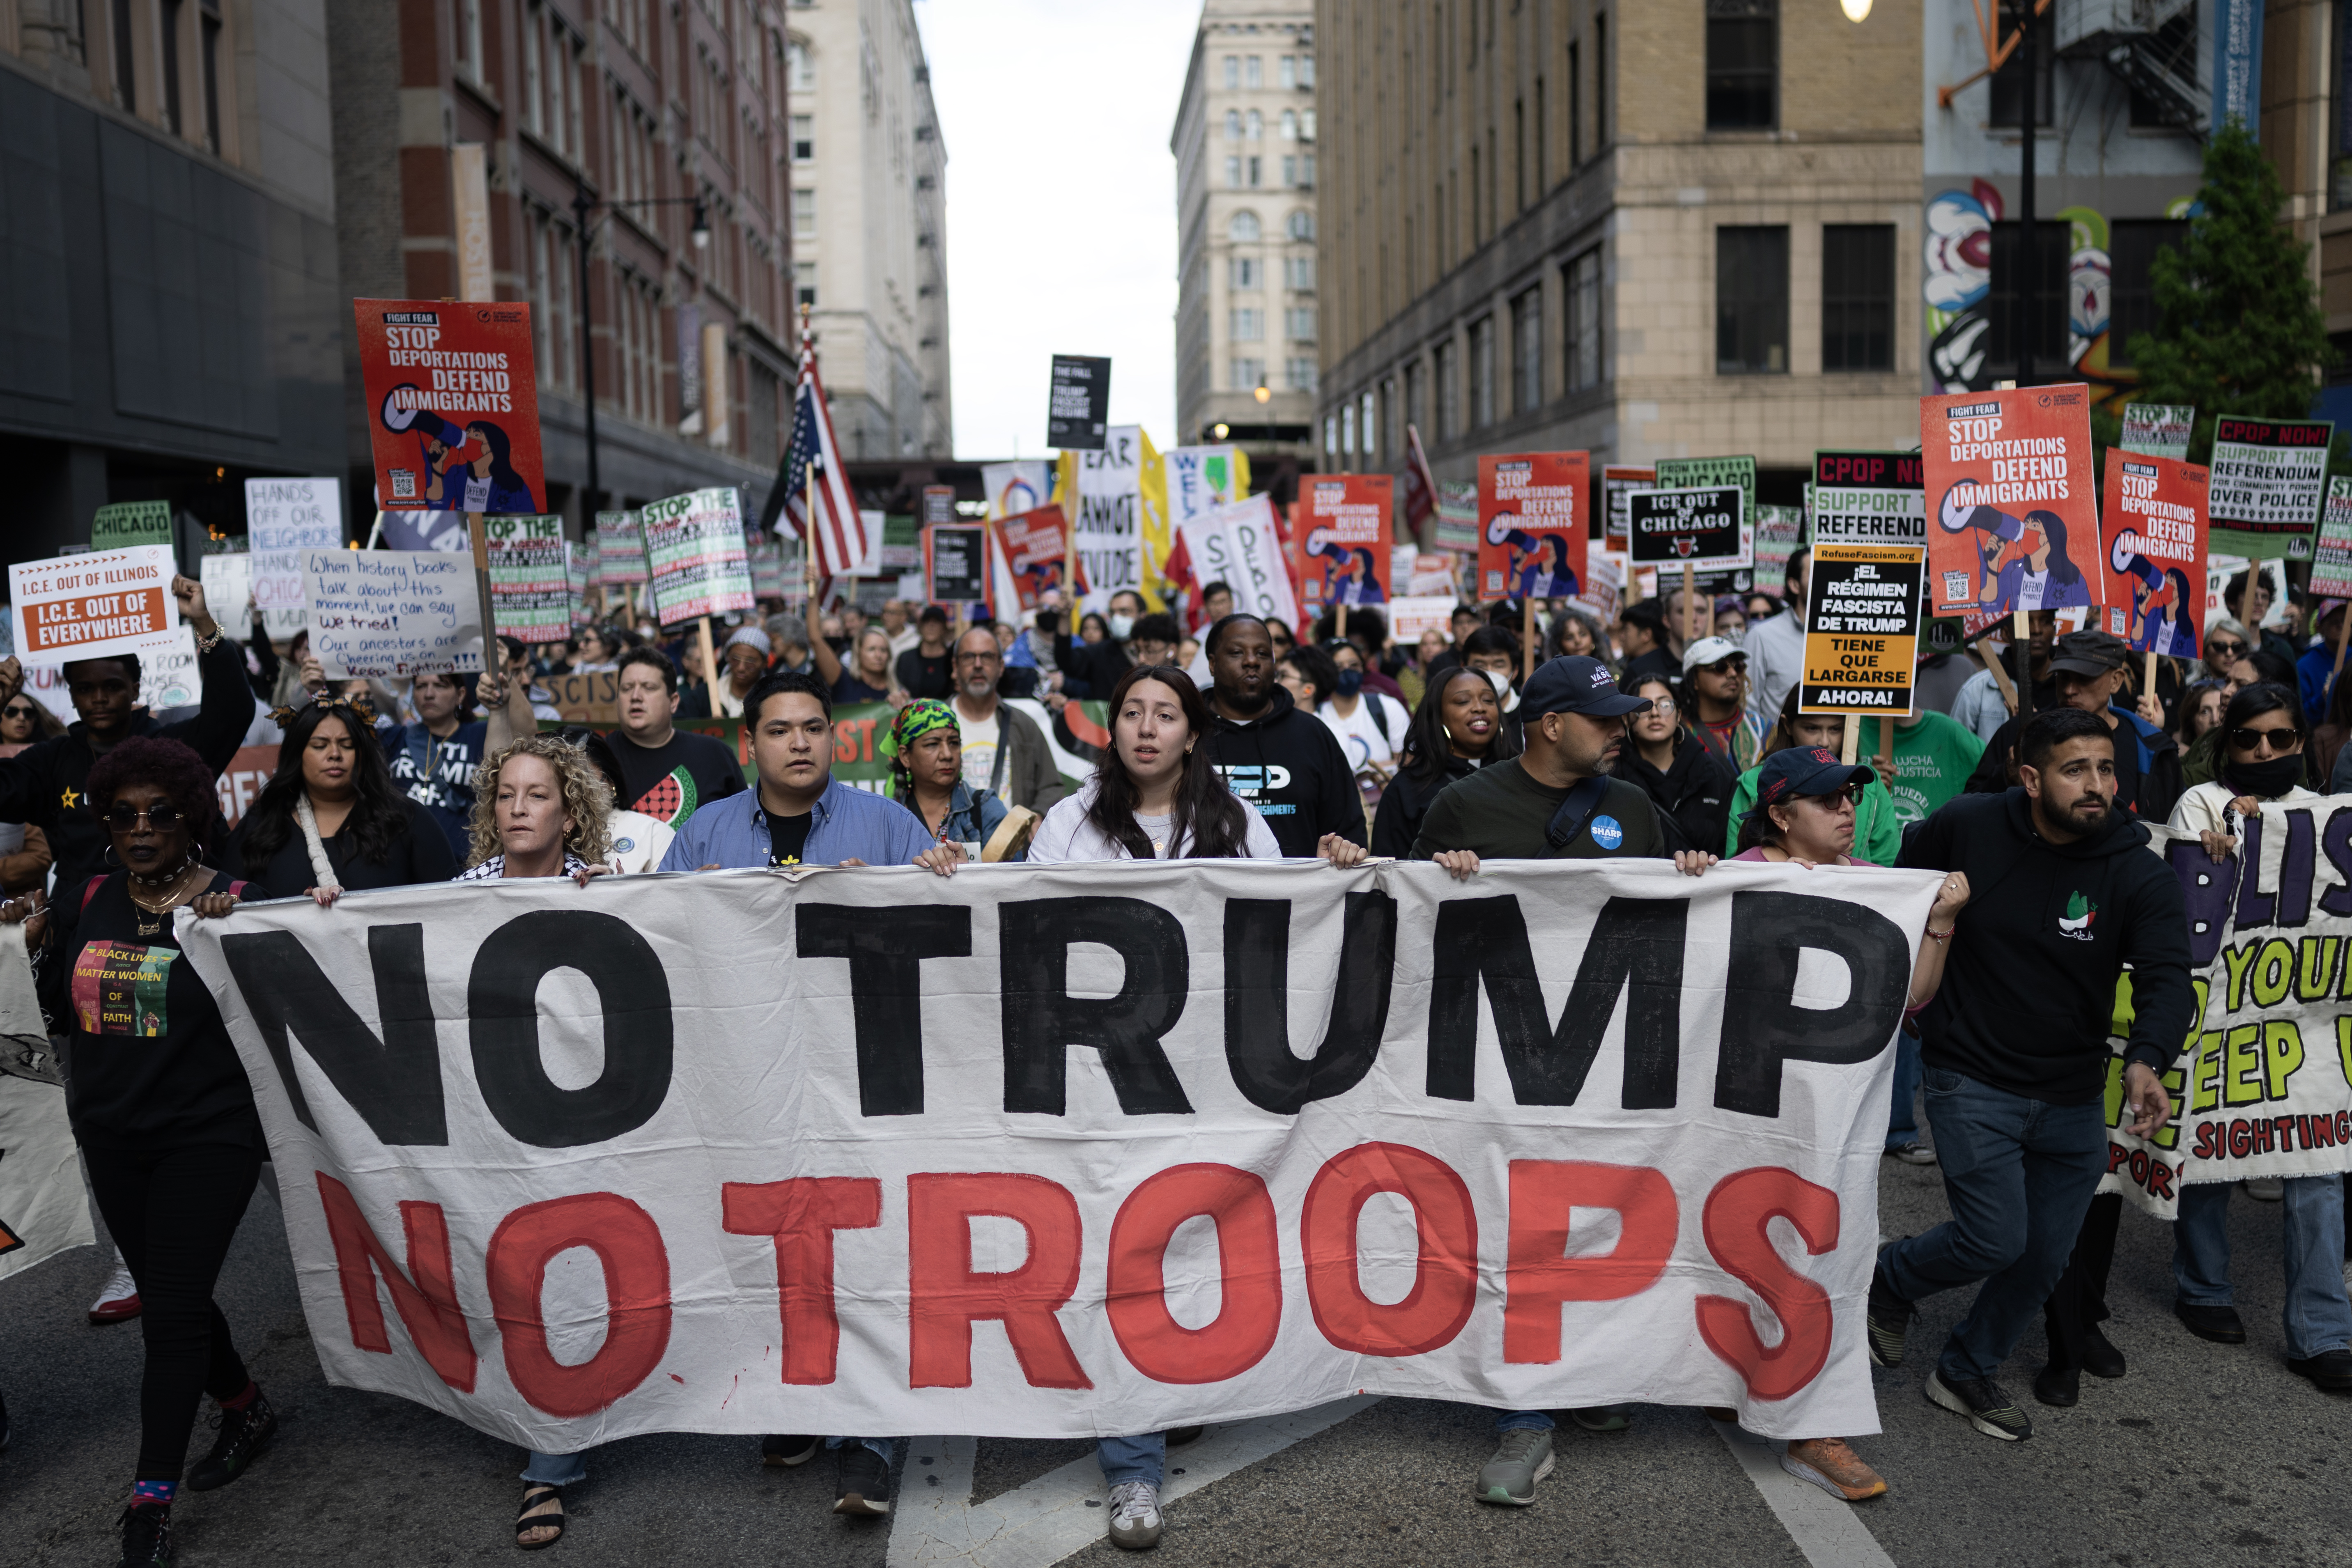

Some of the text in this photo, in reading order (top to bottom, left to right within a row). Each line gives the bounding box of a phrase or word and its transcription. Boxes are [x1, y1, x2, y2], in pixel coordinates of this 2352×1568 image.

[387, 314, 433, 324] FIGHT FEAR
[386, 327, 440, 349] STOP
[389, 350, 508, 370] DEPORTATIONS
[432, 370, 510, 393] DEFEND
[394, 389, 512, 413] IMMIGRANTS
[1950, 405, 1996, 417] FIGHT FEAR
[2128, 406, 2166, 422] STOP
[1949, 418, 2002, 443] STOP
[2220, 421, 2327, 445] CPOP NOW!
[1951, 437, 2066, 462] DEPORTATIONS
[2217, 446, 2323, 464] SUPPORT THE
[1820, 457, 1885, 482] CPOP
[1993, 456, 2067, 482] DEFEND
[2125, 463, 2154, 476] FIGHT FEAR
[2215, 461, 2321, 481] REFERENDUM
[1496, 472, 1532, 487] STOP
[1661, 473, 1750, 490] CHICAGO
[2122, 475, 2158, 499] STOP
[2213, 479, 2319, 491] FOR COMMUNITY POWER
[251, 482, 313, 505] HANDS
[466, 485, 487, 497] DEFEND
[1314, 491, 1346, 505] STOP
[1495, 485, 1573, 500] DEPORTATIONS
[1952, 479, 2069, 507] IMMIGRANTS
[2211, 489, 2317, 507] OVER POLICE
[645, 491, 734, 524] STOP THE
[1314, 504, 1380, 517] DEPORTATIONS
[1522, 498, 1573, 515] DEFEND
[1651, 493, 1719, 510] ICE OUT
[1818, 492, 1911, 512] SUPPORT
[2122, 495, 2195, 523] DEPORTATIONS
[253, 504, 326, 528] OFF OUR
[1495, 514, 1573, 529] IMMIGRANTS
[1677, 507, 1694, 518] OF
[93, 515, 168, 535] CHICAGO
[521, 519, 559, 537] THE
[1336, 516, 1379, 530] DEFEND
[1640, 512, 1730, 533] CHICAGO
[1818, 515, 1925, 537] REFEREND
[2148, 517, 2195, 544] DEFEND
[2226, 520, 2251, 530] POWER
[2255, 522, 2264, 530] TO
[2267, 522, 2280, 532] THE
[2283, 523, 2313, 533] PEOPLE
[253, 526, 341, 549] NEIGHBORS
[1313, 529, 1379, 543] IMMIGRANTS
[1821, 550, 1915, 561] RefuseFascism.org
[2120, 533, 2194, 563] IMMIGRANTS
[23, 565, 159, 596] I.C.E. OUT OF ILLINOIS
[310, 553, 457, 592] When history books
[1854, 565, 1881, 581] ¡EL
[317, 577, 442, 597] talk about this
[1828, 579, 1907, 597] RÉGIMEN
[2023, 580, 2043, 593] DEFEND
[38, 592, 147, 624] I.C.E. OUT OF
[377, 602, 395, 615] we
[400, 603, 424, 615] can
[429, 601, 456, 629] say
[1821, 599, 1906, 614] FASCISTA
[38, 613, 153, 646] EVERYWHERE
[348, 615, 400, 631] tried!
[1818, 616, 1907, 632] DE TRUMP
[319, 634, 459, 653] Our ancestors are
[1831, 638, 1886, 652] TIENE
[156, 652, 194, 671] ROOM
[336, 650, 436, 672] Cheering us on
[1840, 654, 1879, 669] QUE
[346, 665, 387, 678] Keep
[1810, 669, 1907, 684] LARGARSE
[1818, 689, 1893, 706] AHORA!
[1811, 748, 1838, 764] THE MET
[1895, 755, 1934, 766] LUCHA
[1897, 766, 1942, 778] JUSTICIA
[1894, 785, 1929, 810] PUEDE!
[1592, 826, 1622, 838] SHARP
[96, 948, 158, 963] BLACK LIVES
[76, 968, 162, 982] MATTER WOMEN
[108, 992, 122, 1001] OF
[103, 1012, 132, 1023] FAITH
[220, 909, 674, 1149] NO
[795, 889, 1910, 1119] TRUMP
[2192, 1110, 2352, 1160] SIGHTING
[316, 1141, 1841, 1419] NO TROOPS
